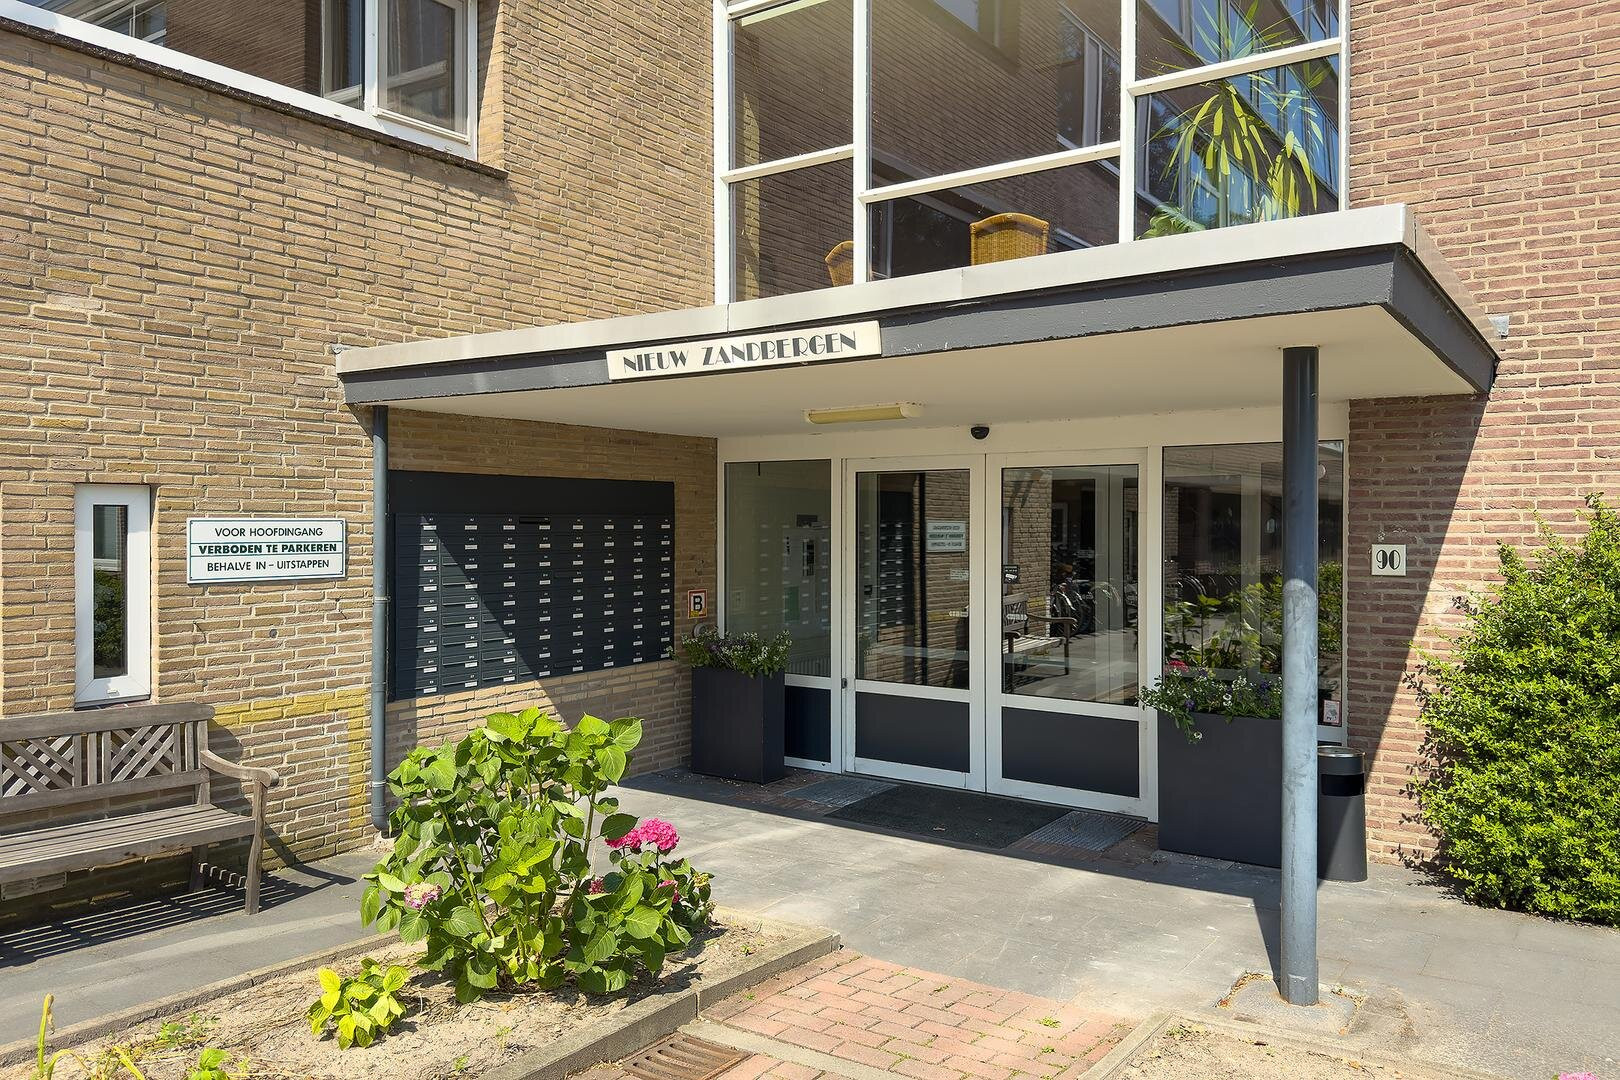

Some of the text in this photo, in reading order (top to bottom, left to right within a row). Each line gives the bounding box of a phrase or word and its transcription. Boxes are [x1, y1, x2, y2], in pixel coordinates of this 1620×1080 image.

[623, 330, 857, 373] NIEUW ZANDBERGEN
[214, 527, 323, 537] VOOR HOOFDINGANG
[198, 543, 337, 554] VERBODEN TE PARKEREN
[207, 562, 251, 571] BEHALVE
[255, 561, 266, 570] IN
[276, 560, 330, 570] UITSTAPPEN
[1376, 549, 1401, 570] 90
[693, 595, 703, 612] B
